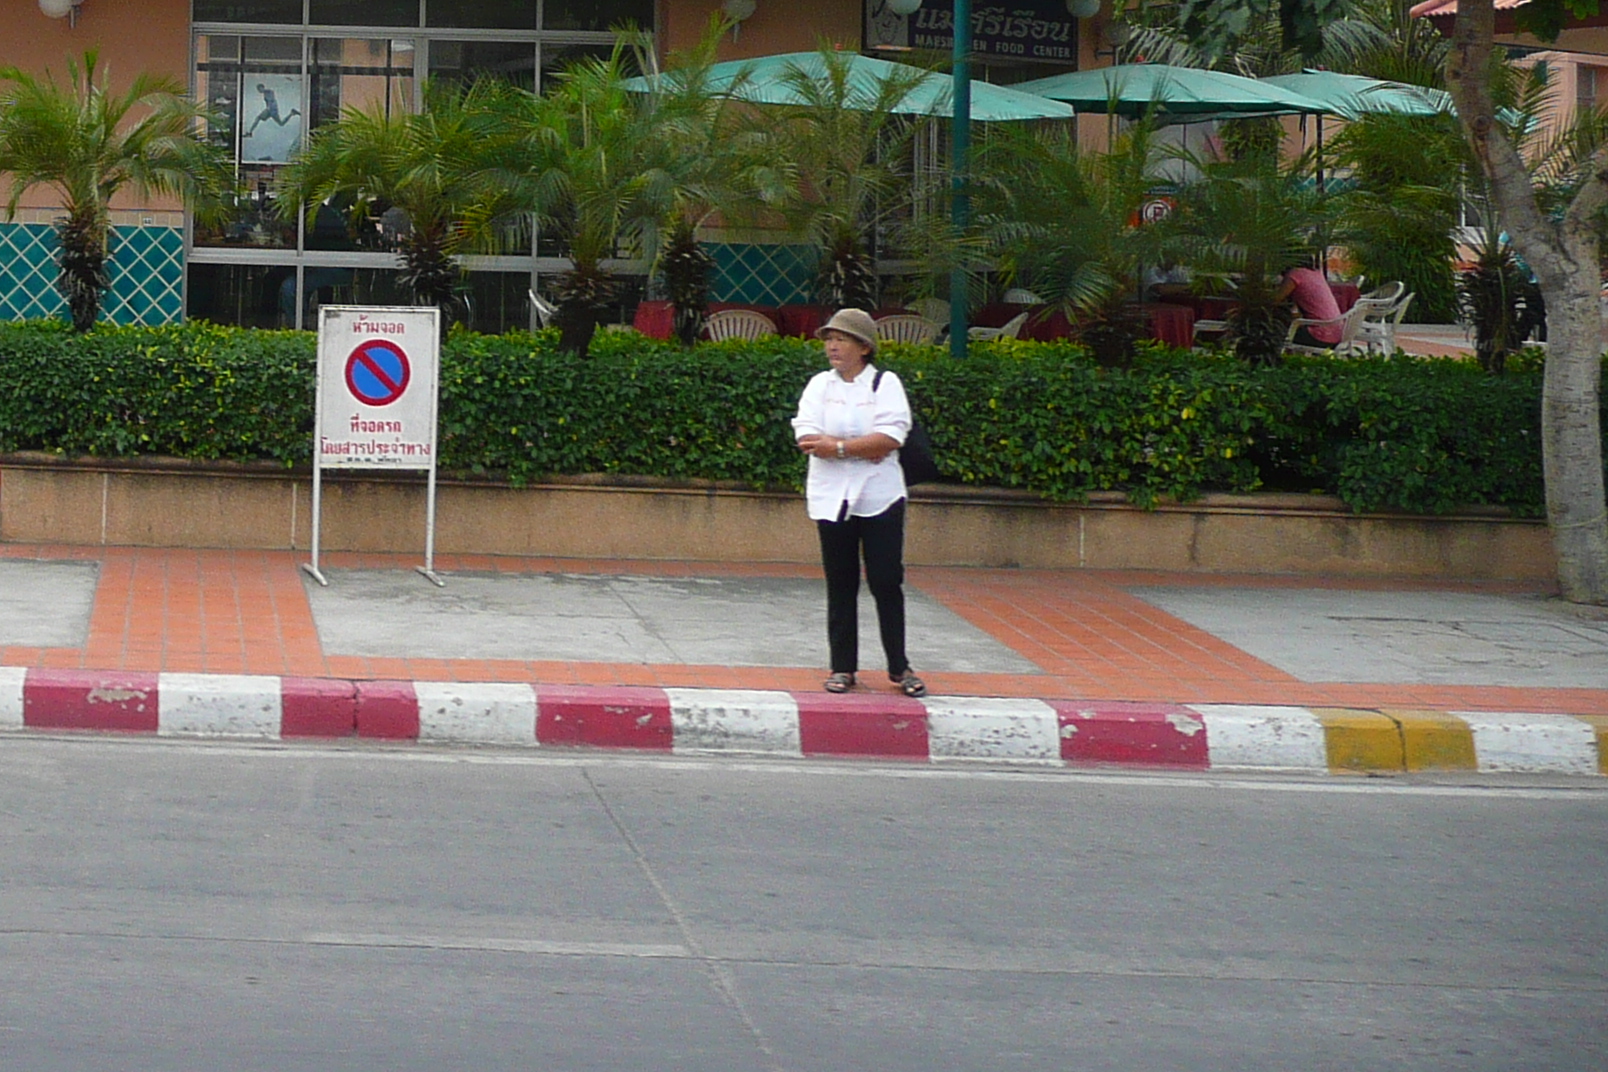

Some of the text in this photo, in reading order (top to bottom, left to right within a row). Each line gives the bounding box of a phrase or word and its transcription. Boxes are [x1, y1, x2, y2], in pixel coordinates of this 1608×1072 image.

[915, 33, 1071, 58] MAESREN FOOD CENTER
[352, 314, 405, 334] ห้ามจอด
[350, 413, 402, 433] ที่จอดรถ
[320, 436, 431, 456] โดยสารประจำทาง
